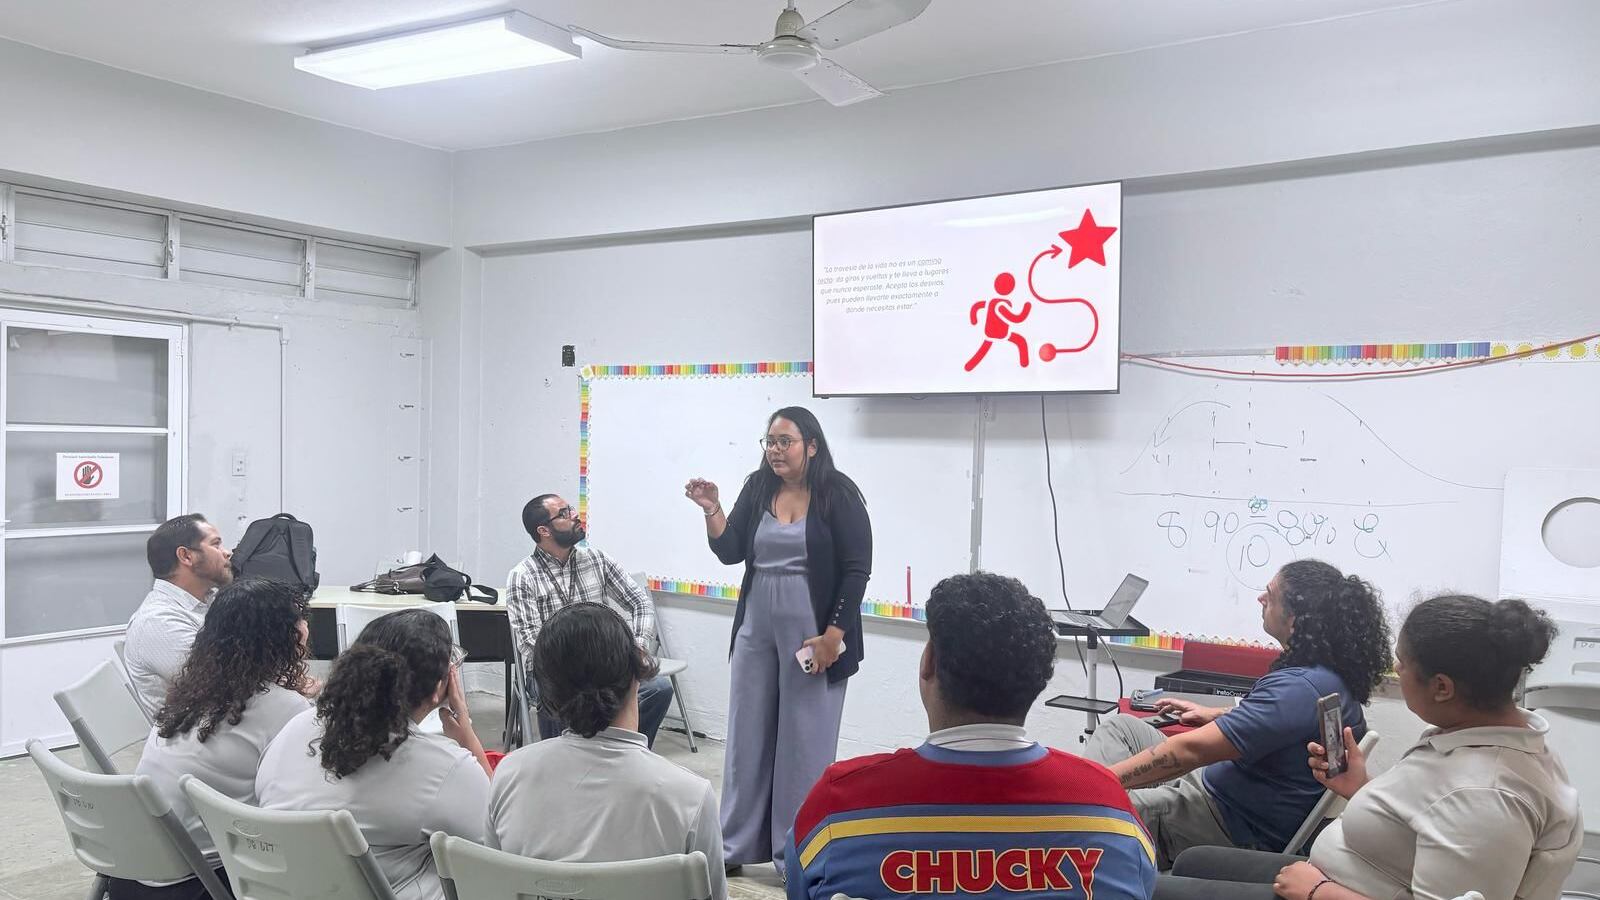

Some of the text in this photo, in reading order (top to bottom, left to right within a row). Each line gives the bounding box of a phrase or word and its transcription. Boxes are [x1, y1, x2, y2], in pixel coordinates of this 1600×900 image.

[845, 276, 860, 284] giros
[821, 287, 832, 295] que
[842, 296, 865, 304] pueden
[891, 292, 933, 300] exactamente
[866, 304, 895, 312] necesitas
[1240, 534, 1271, 571] 10
[880, 848, 1104, 899] CHUCKY
